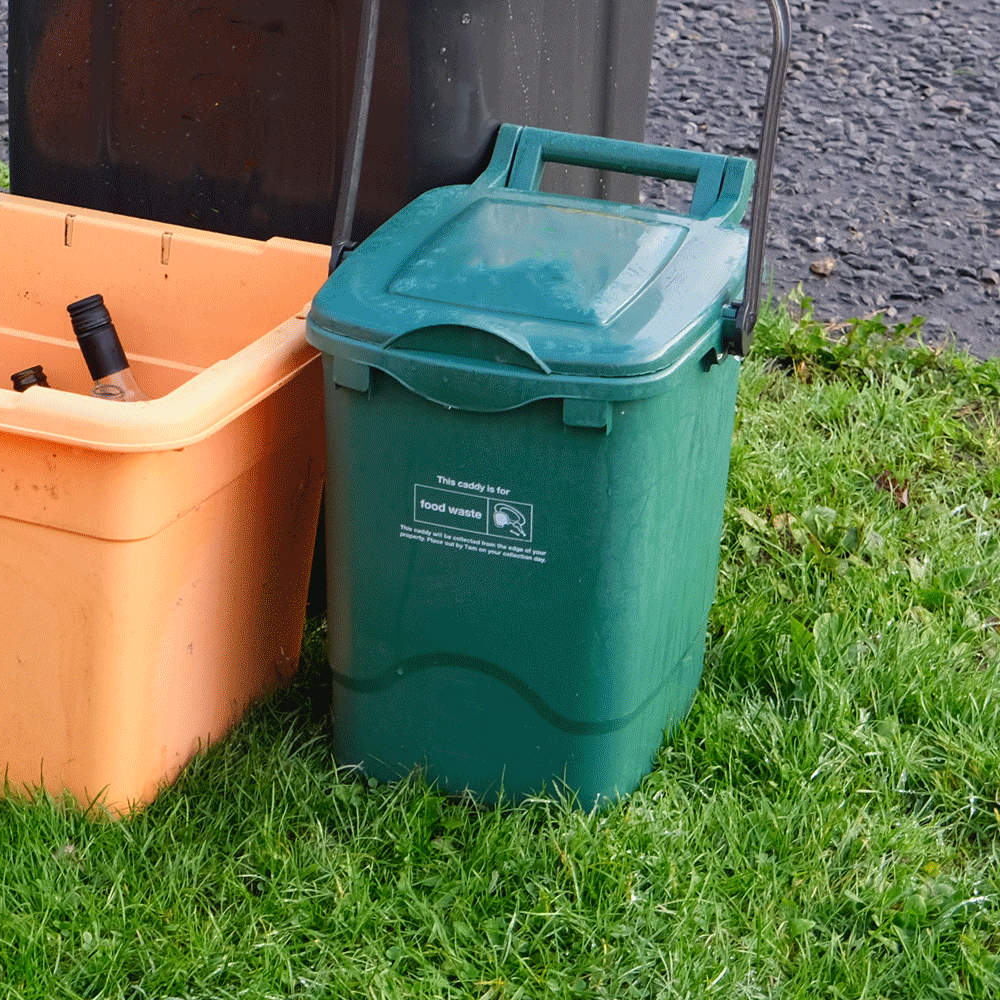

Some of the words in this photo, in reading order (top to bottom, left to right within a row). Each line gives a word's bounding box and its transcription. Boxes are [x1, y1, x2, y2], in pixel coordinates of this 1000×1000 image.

[437, 475, 456, 487] This
[457, 480, 485, 493] caddy
[487, 484, 495, 494] is
[497, 485, 511, 496] for
[420, 499, 446, 513] food
[448, 506, 482, 520] waste
[400, 524, 412, 533] This
[413, 527, 432, 537] caddy
[433, 530, 443, 538] will
[443, 533, 452, 541] be
[453, 534, 481, 546] collected
[482, 540, 496, 548] from
[497, 542, 507, 550] the
[532, 549, 547, 557] your
[427, 536, 444, 546] Place
[444, 539, 455, 548] out
[455, 541, 464, 550] by
[464, 543, 478, 552] 7am
[487, 548, 501, 556] your
[502, 550, 533, 561] collection
